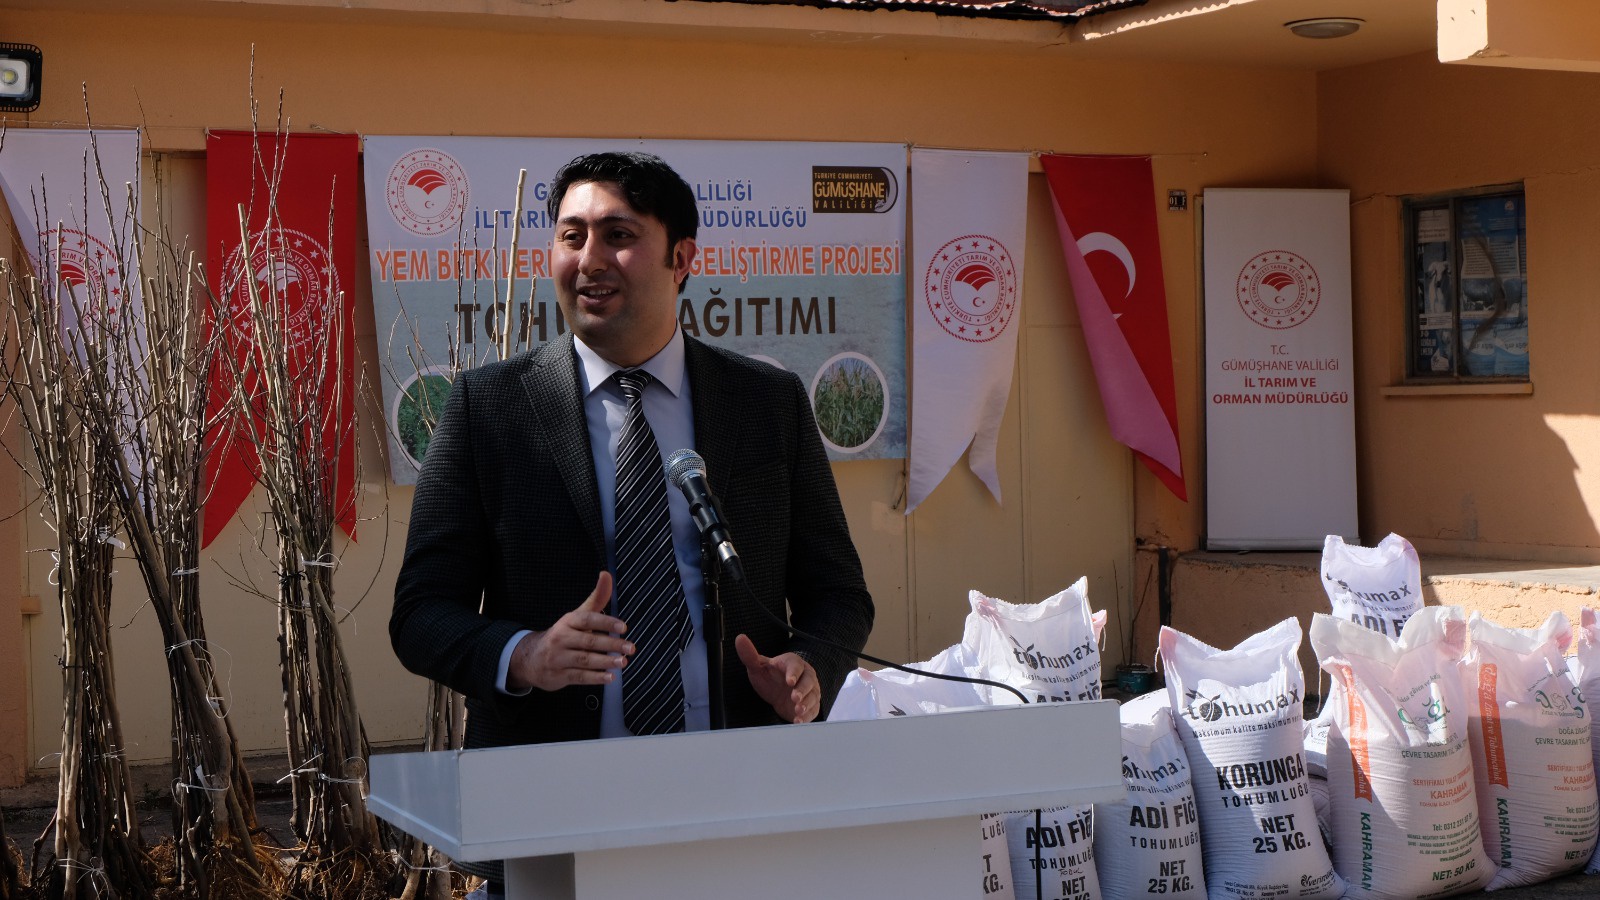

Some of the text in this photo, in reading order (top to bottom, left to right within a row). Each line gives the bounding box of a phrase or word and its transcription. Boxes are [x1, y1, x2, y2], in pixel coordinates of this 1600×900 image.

[696, 180, 752, 201] LİLİĞİ
[814, 181, 885, 200] GÜMÜŞHANE
[814, 199, 873, 209] VALİLİĞİ
[475, 206, 494, 229] İL
[699, 206, 807, 228] ÜDÜRLÜĞÜ
[52, 251, 77, 260] TRIM
[376, 242, 554, 281] YEM BİTKLERİ
[689, 240, 900, 282] GELİŞTİRME PROJESİ
[303, 262, 318, 291] ORMAN
[944, 257, 966, 300] CUMHURİYETİ
[989, 258, 996, 266] VE
[454, 301, 566, 344] TOH
[678, 287, 836, 338] AĞITIMI
[1270, 344, 1289, 355] T.C.
[1221, 358, 1339, 373] GÜMÜŞHANE VALİLİĞİ
[1244, 377, 1316, 388] İL TARIM VE
[1212, 391, 1349, 404] ORMAN MÜDÜRLÜĞÜ
[1013, 641, 1095, 670] tohumax
[1187, 688, 1300, 722] tohumax
[1193, 728, 1232, 739] Maksimum
[1233, 725, 1256, 734] kalite
[1258, 718, 1291, 730] maksimum
[1535, 738, 1554, 746] ÇEVRE
[1554, 738, 1578, 746] TASARIM
[1401, 750, 1422, 759] ÇEVRE
[1215, 753, 1305, 791] KORUNGA
[1222, 782, 1309, 809] TOHUMLUĞU
[1430, 781, 1468, 800] KAHRAMAN
[1130, 795, 1197, 829] ADİ FİĞ
[1026, 820, 1066, 849] ADİ
[1067, 808, 1092, 844] FİĞ
[1260, 814, 1295, 834] NET
[1432, 824, 1442, 832] Tel:
[1497, 797, 1512, 869] KAHRAMAN
[1130, 831, 1199, 850] TOHUMLUĞU
[1252, 831, 1311, 854] 25 KG.
[1360, 812, 1373, 892] KAHRAMAN
[1160, 860, 1186, 877] NET
[1432, 858, 1476, 882] NET: 50 KG
[1062, 876, 1086, 896] NET
[1148, 876, 1194, 894] 25 KG.
